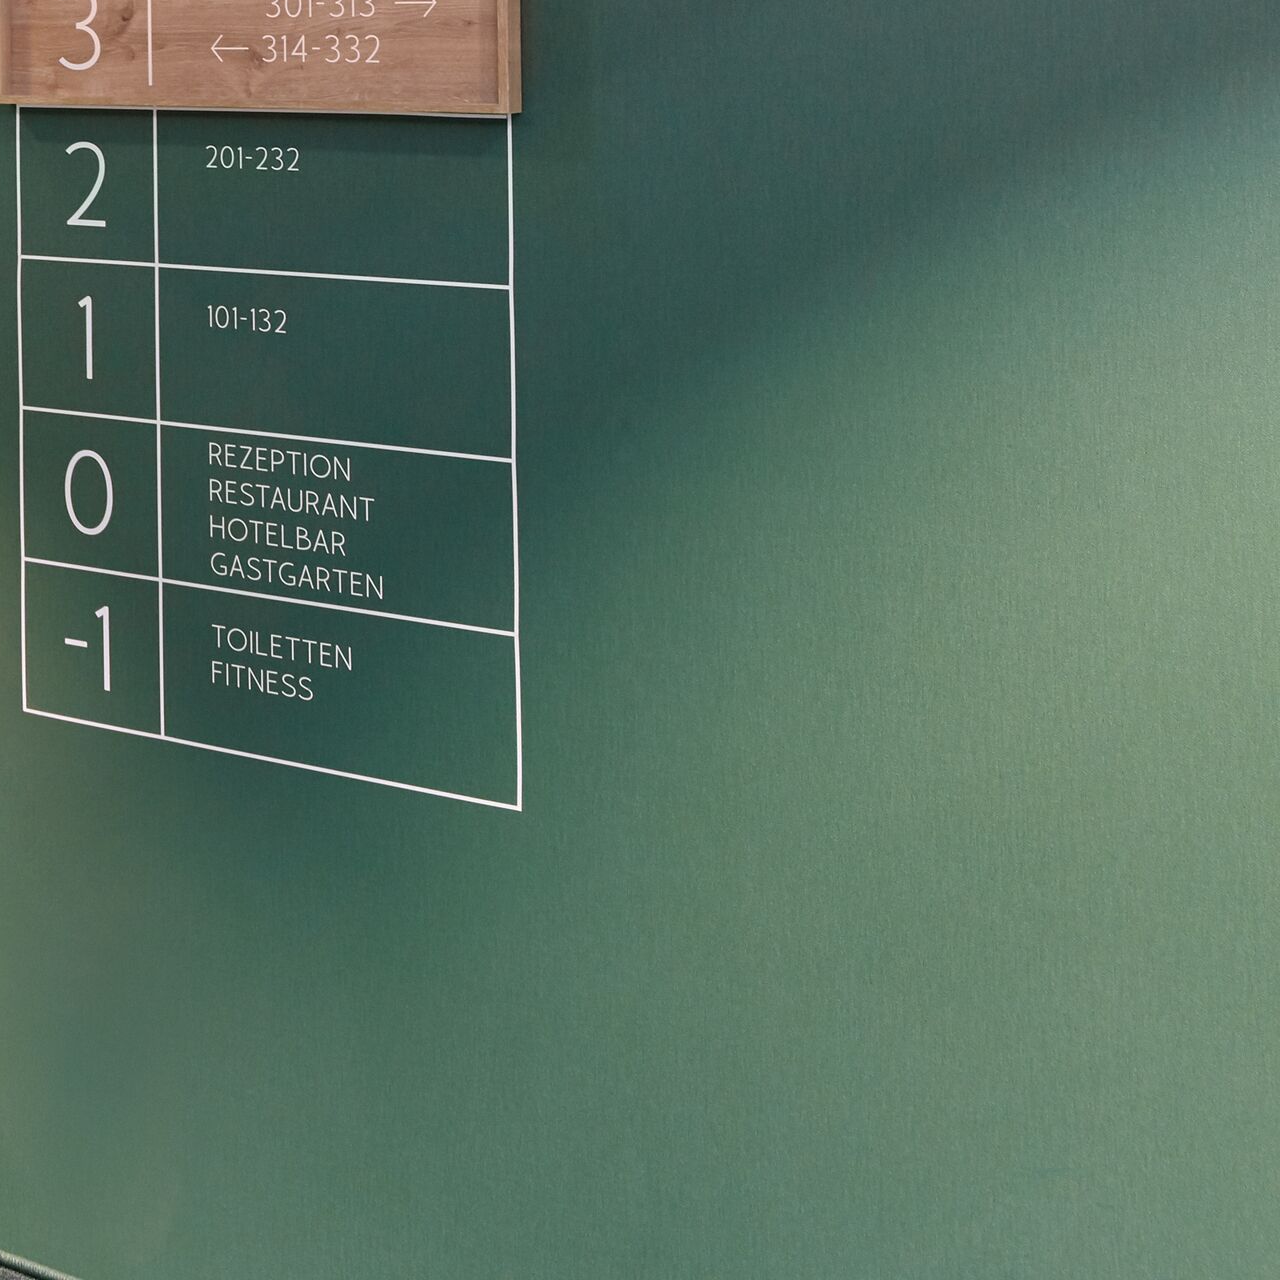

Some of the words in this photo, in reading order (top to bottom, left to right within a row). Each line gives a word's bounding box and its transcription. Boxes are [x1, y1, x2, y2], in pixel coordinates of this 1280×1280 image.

[262, 34, 381, 63] 314-332
[205, 145, 300, 171] 201-232
[66, 142, 106, 227] 2
[78, 296, 93, 380] 1
[207, 305, 287, 334] 101-132
[209, 442, 351, 481] REZEPTION
[65, 450, 113, 535] 0
[209, 478, 375, 521] RESTAURANT
[209, 515, 346, 556] HOTELBAR
[210, 552, 383, 599] GASTGARTEN
[65, 606, 110, 691] -1
[211, 624, 352, 670] TOILETTEN
[211, 660, 314, 701] FITNESS
